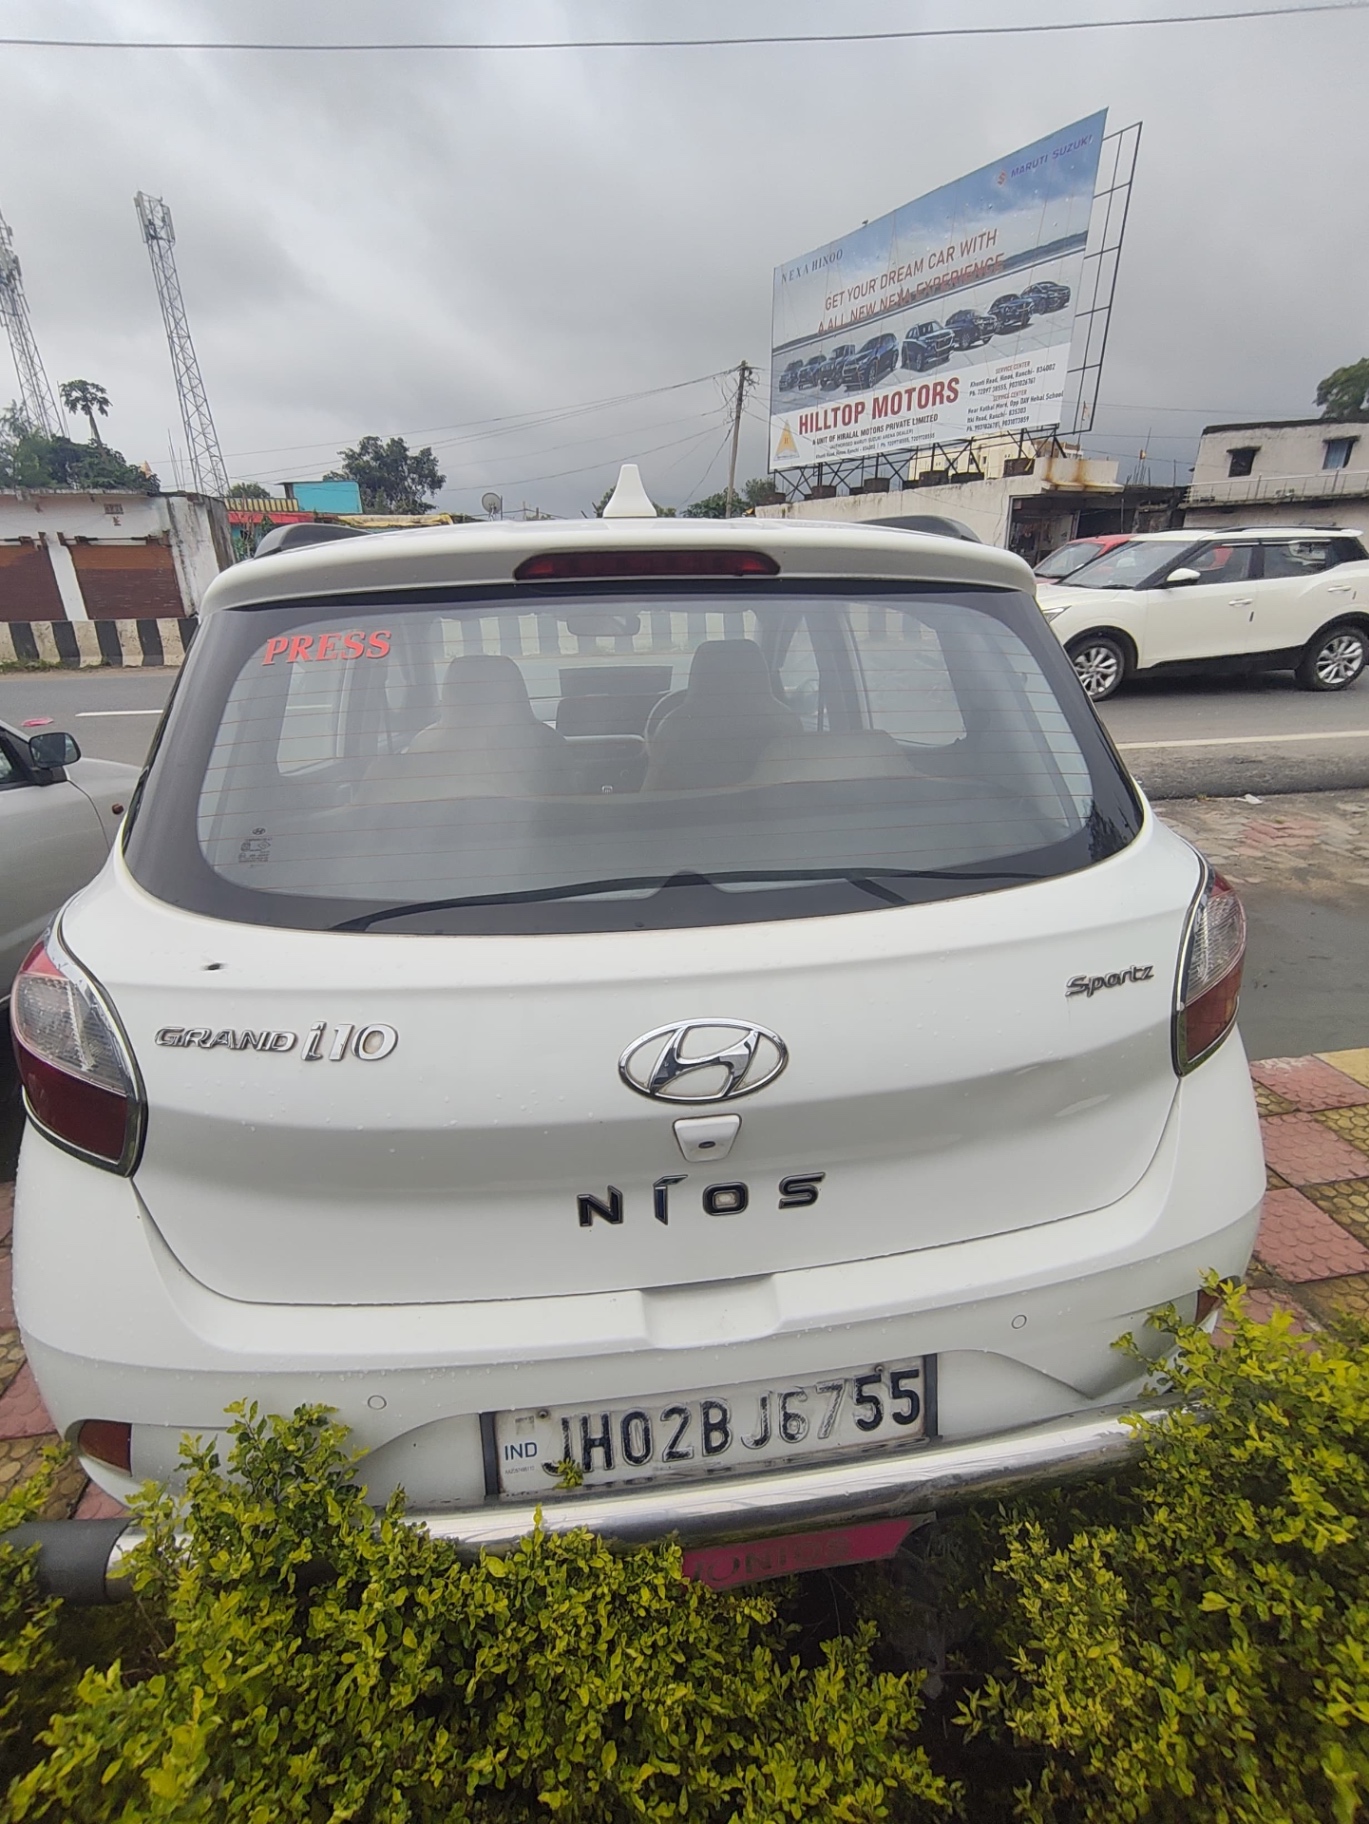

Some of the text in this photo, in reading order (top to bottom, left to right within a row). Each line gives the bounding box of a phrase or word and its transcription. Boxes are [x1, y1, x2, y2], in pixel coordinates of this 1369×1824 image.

[1011, 134, 1093, 178] MARUTI SUZUKI
[781, 248, 843, 285] NEXA HINOO
[825, 229, 998, 312] GET YOUR DREAM CAR WITH
[827, 314, 846, 331] ALL
[850, 299, 877, 321] NEW
[880, 287, 911, 313] NEXA
[916, 252, 1005, 296] EXPERIENCE
[995, 360, 1031, 374] SERVICE CENTER
[799, 377, 960, 435] HILLTOP MOTORS
[1010, 389, 1027, 398] CENTER
[1046, 390, 1064, 400] School
[829, 434, 836, 442] OF
[837, 430, 859, 440] HIRALAL
[861, 426, 884, 436] MOTORS
[885, 418, 911, 431] PRIVATE
[912, 413, 939, 426] LIMITED
[261, 630, 392, 666] PRESS
[1065, 955, 1154, 997] Sportz
[154, 1021, 399, 1062] GRAND i10
[577, 1171, 826, 1227] NIOS
[541, 1369, 920, 1477] JH02BJ6755
[505, 1442, 538, 1461] IND
